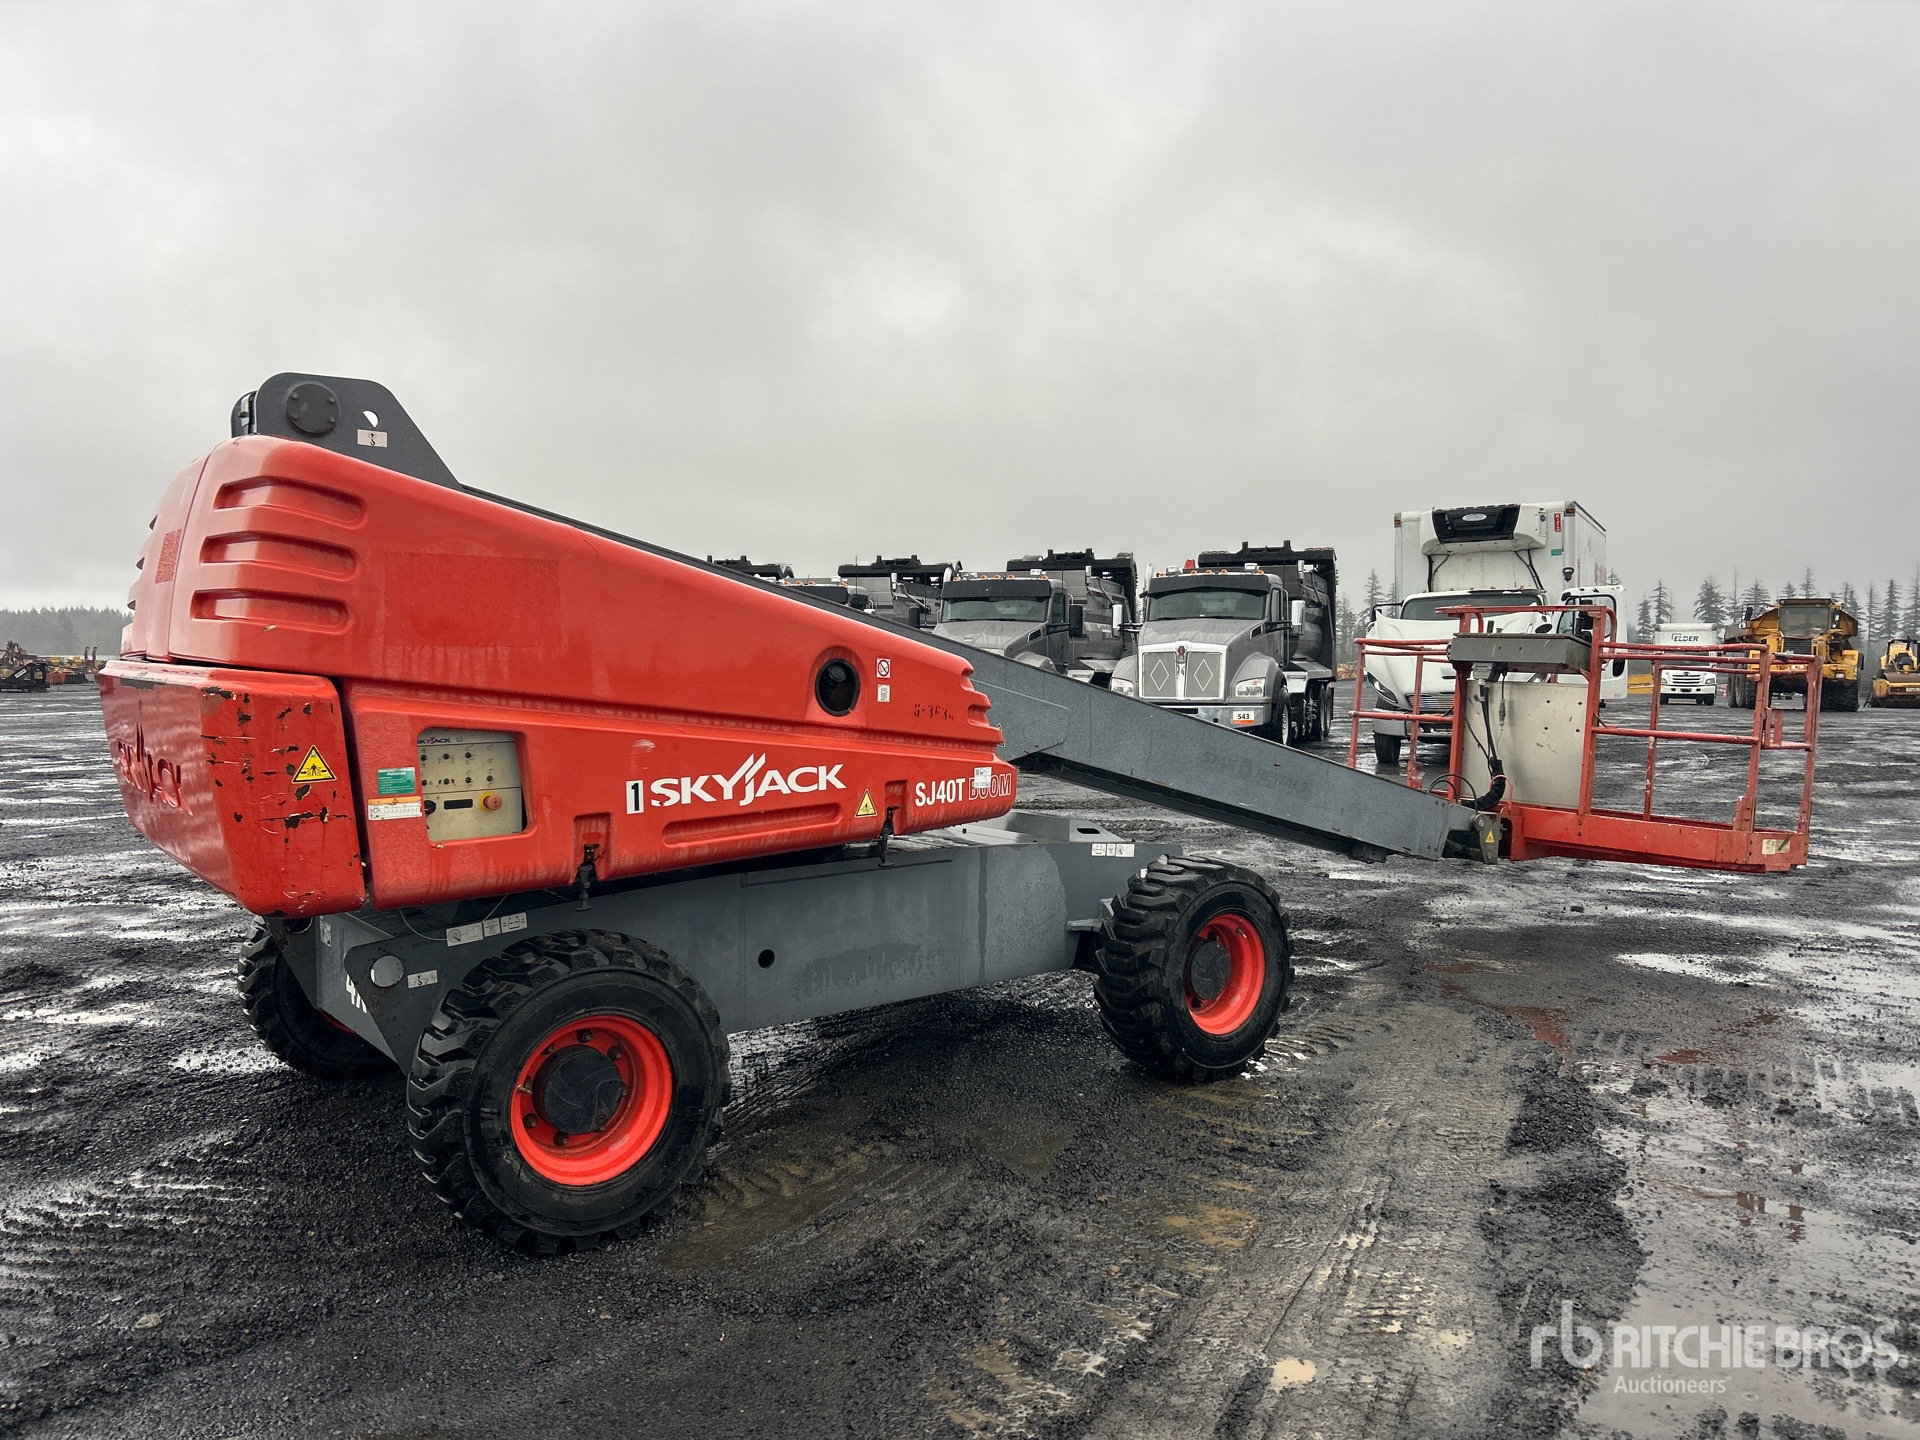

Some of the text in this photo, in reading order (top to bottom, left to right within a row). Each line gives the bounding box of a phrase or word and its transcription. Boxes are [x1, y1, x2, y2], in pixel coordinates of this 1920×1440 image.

[1672, 634, 1699, 642] ELDER
[650, 752, 847, 807] SKYJACK
[915, 778, 966, 807] SJ40T
